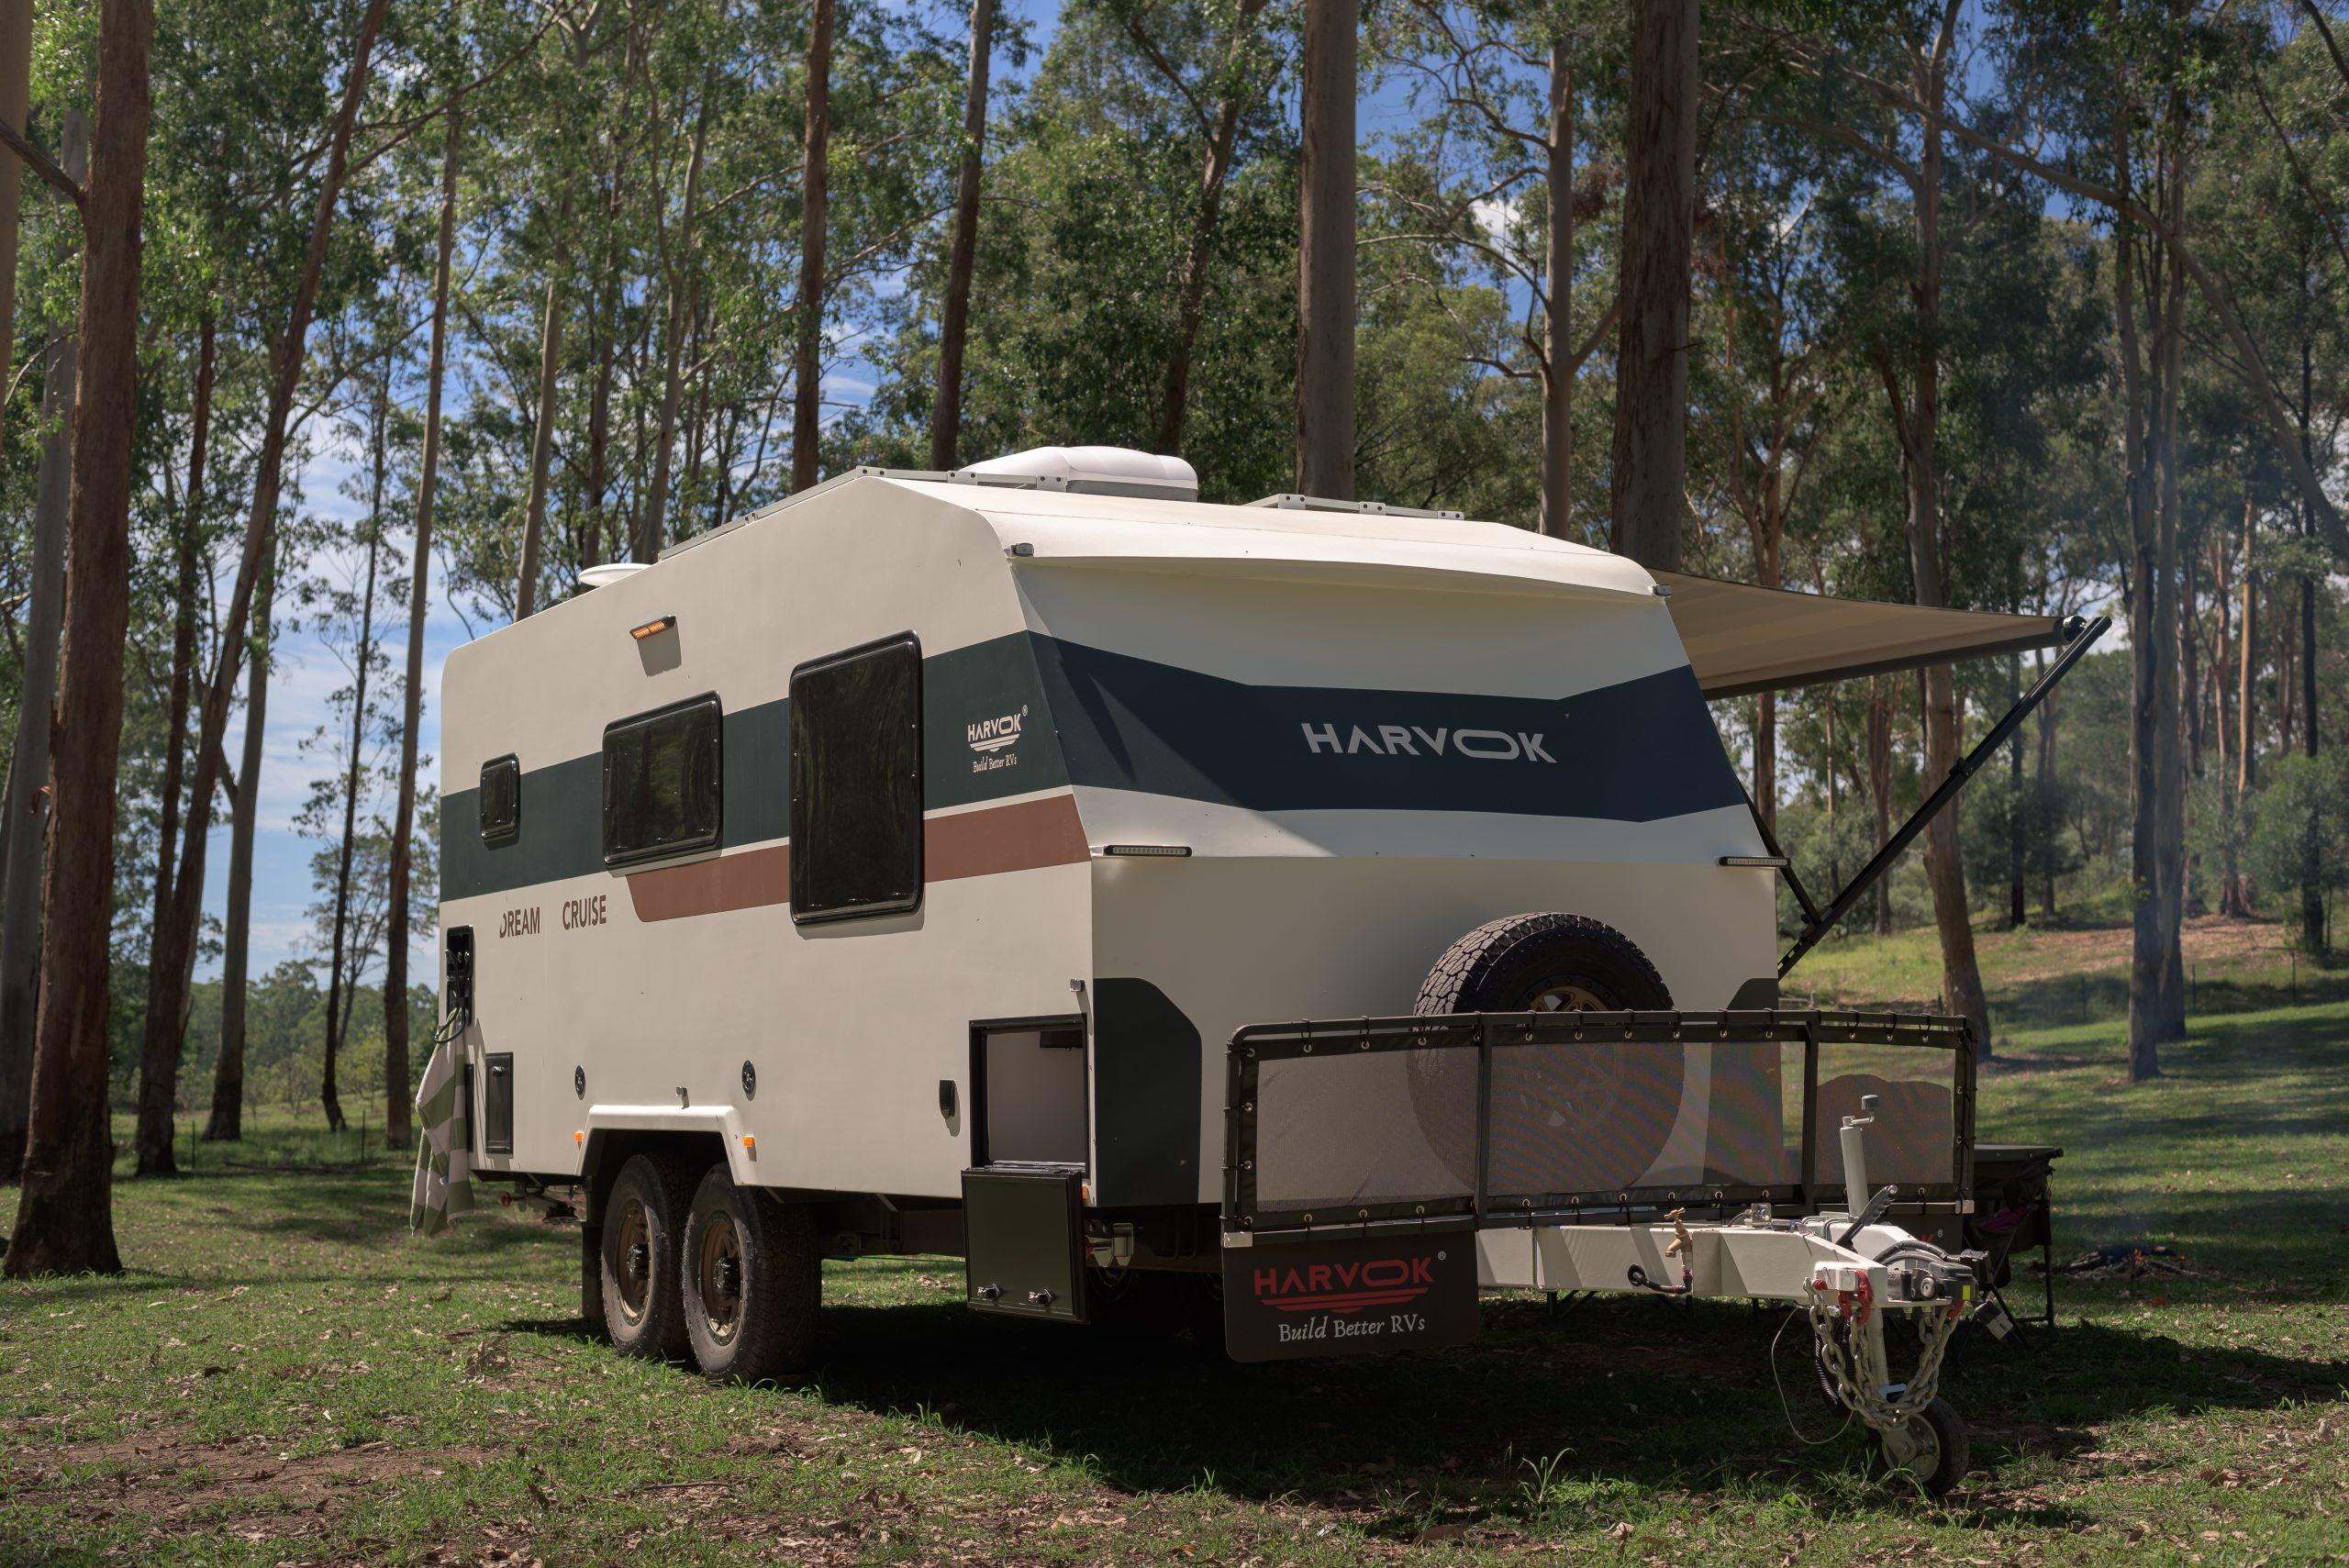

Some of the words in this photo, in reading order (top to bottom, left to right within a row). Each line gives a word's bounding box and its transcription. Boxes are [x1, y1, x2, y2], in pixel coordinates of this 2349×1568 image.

[968, 714, 1021, 741] HARVOK
[1301, 723, 1557, 763] HARVOK
[973, 756, 988, 773] Build
[989, 758, 1005, 770] Better
[1006, 753, 1018, 767] RVs
[562, 895, 607, 930] CRUISE
[1253, 1257, 1434, 1296] HARVOK
[1278, 1316, 1330, 1342] Build
[1333, 1319, 1386, 1339] Better
[1390, 1313, 1426, 1333] RVs
